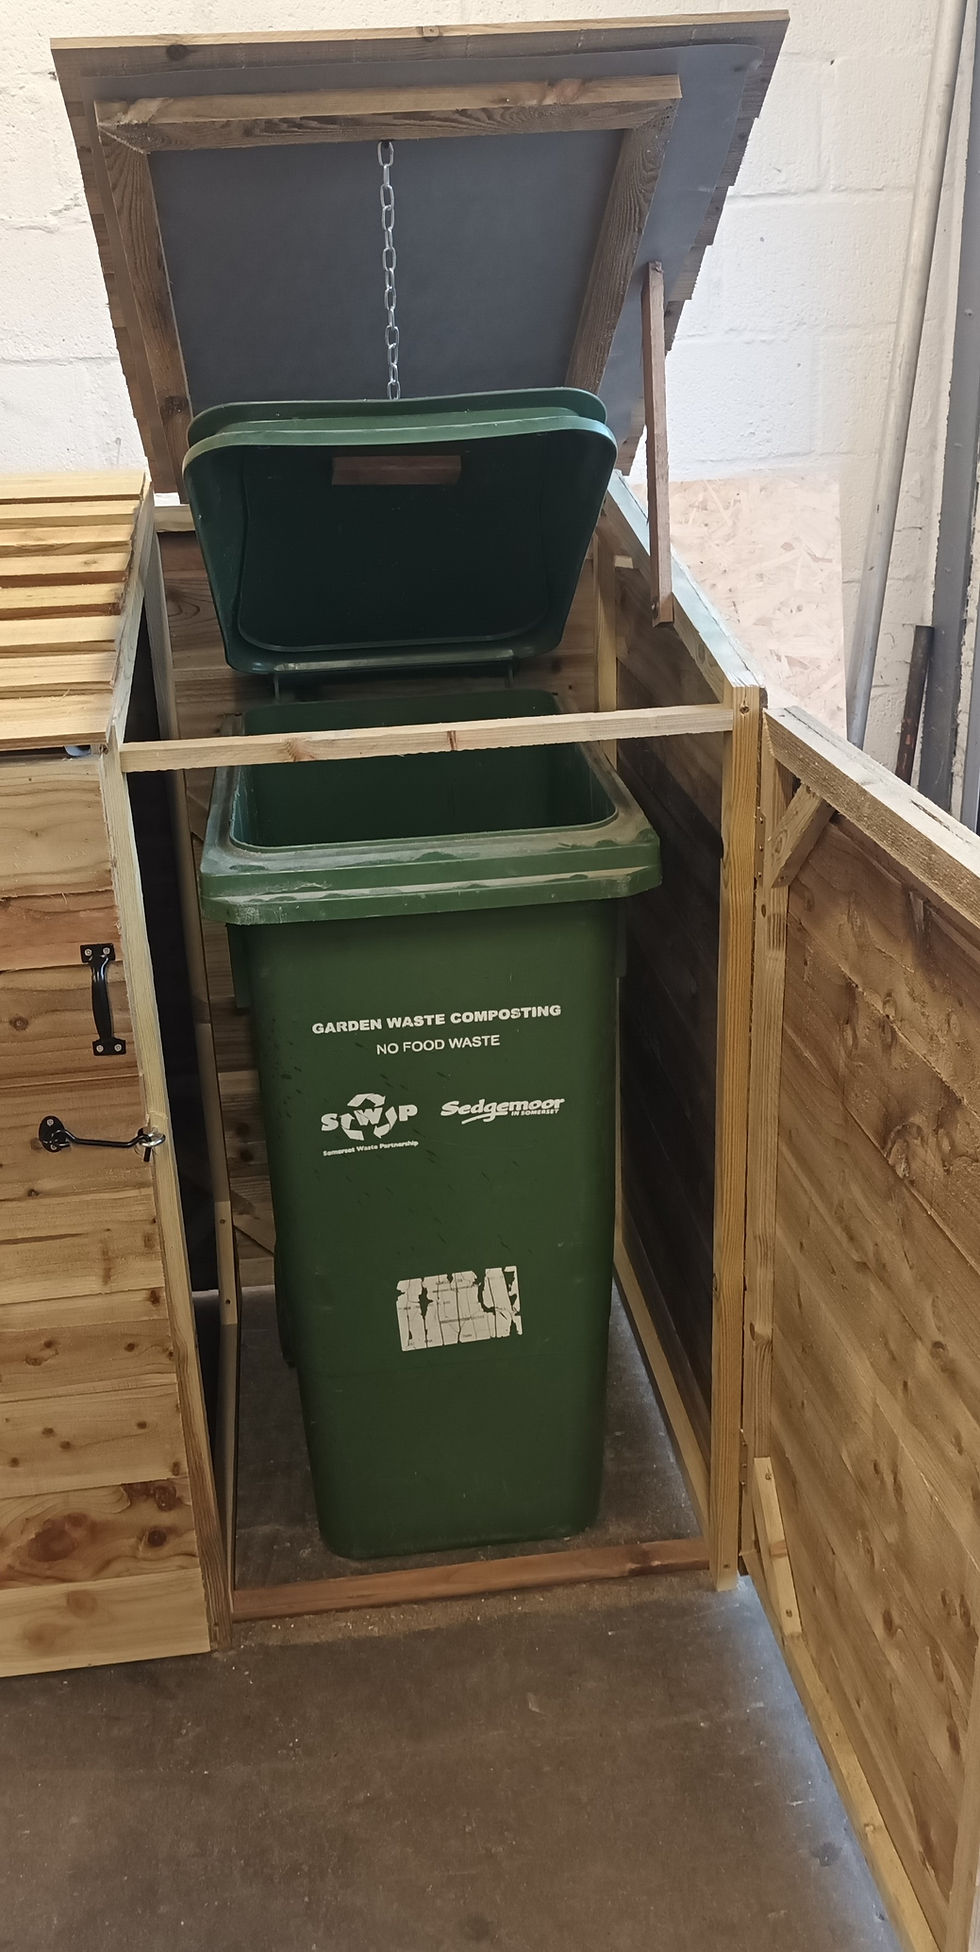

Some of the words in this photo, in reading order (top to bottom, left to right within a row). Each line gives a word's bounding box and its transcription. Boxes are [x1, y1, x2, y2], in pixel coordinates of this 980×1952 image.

[311, 1018, 383, 1034] GARDEN
[386, 1013, 446, 1029] WASTE
[450, 1004, 562, 1024] COMPOSTING
[376, 1042, 400, 1056] NO
[403, 1039, 446, 1053] FOOD
[449, 1034, 501, 1049] WASTE
[440, 1098, 566, 1123] Sedgemoor
[521, 1108, 560, 1116] SOMERSET
[323, 1147, 356, 1157] Somerset
[356, 1144, 378, 1152] Waste
[379, 1140, 419, 1149] Partnership
